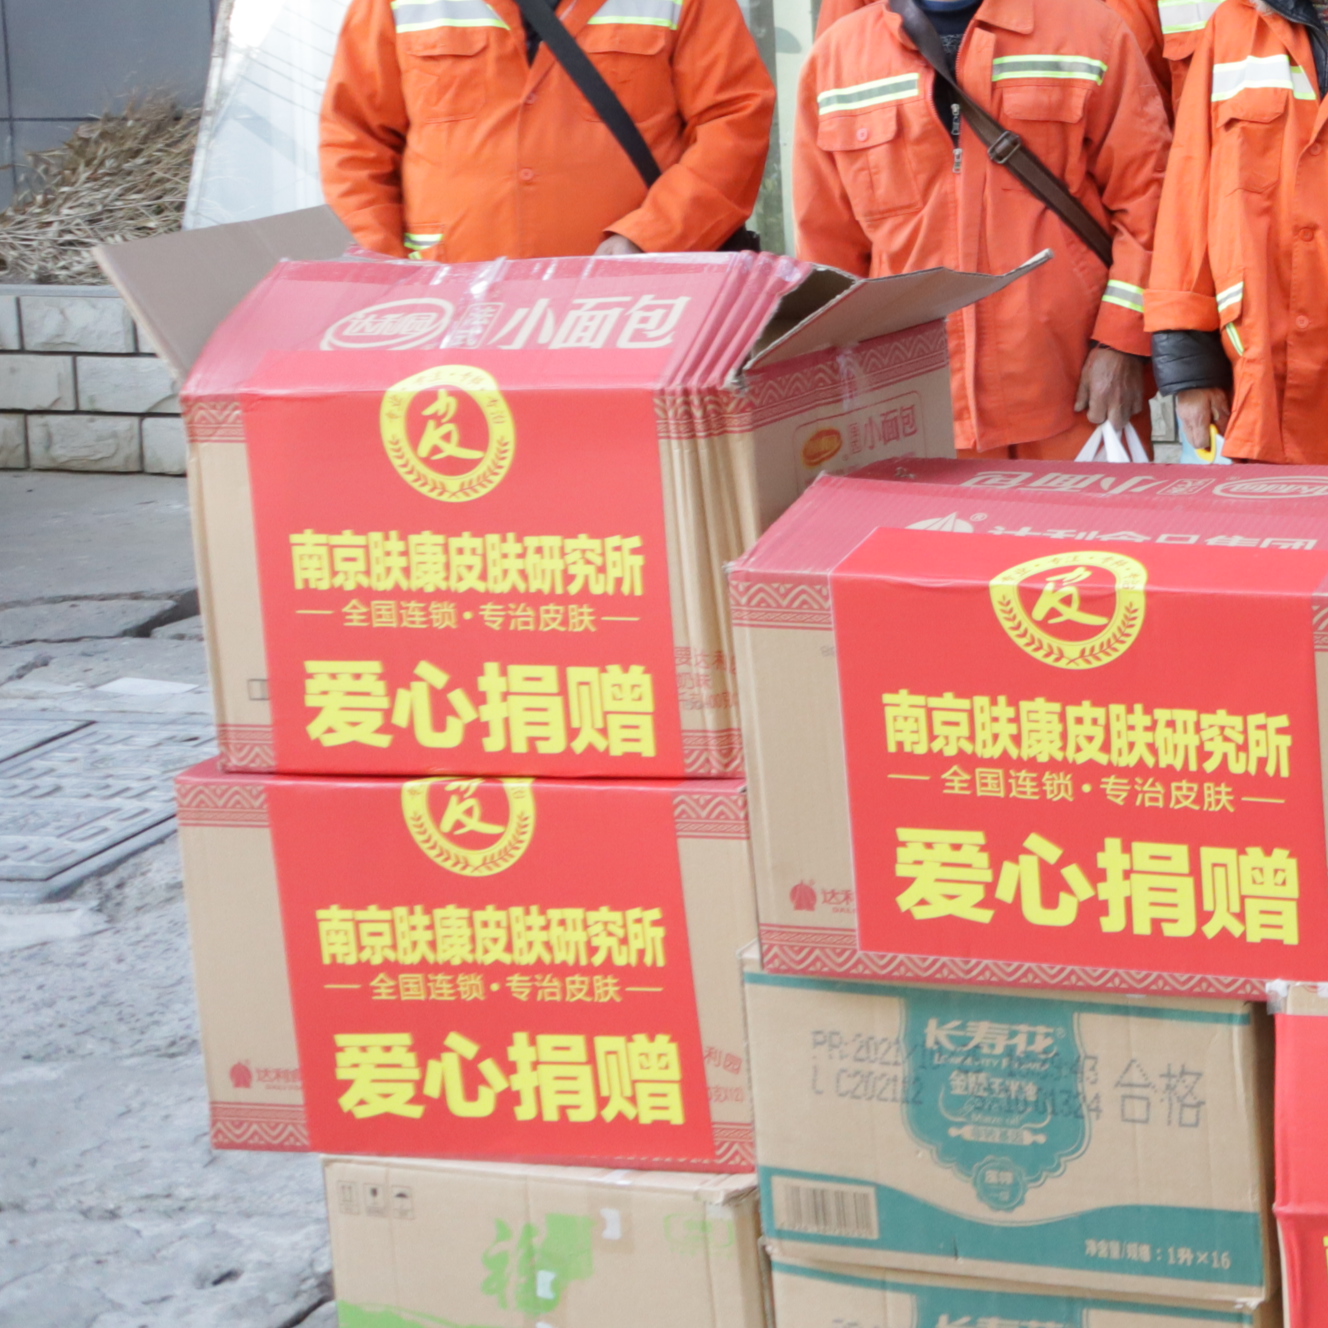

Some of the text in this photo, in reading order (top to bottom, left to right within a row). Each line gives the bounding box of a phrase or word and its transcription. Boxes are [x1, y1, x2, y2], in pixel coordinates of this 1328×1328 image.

[490, 294, 692, 350] 小面包
[288, 528, 646, 598] 南京肤康皮肤研究所
[341, 600, 599, 634] 全国连锁·专治皮肤
[303, 660, 658, 759] 爱心捐赠
[881, 688, 1292, 779] 南京肤康皮肤研究所
[940, 764, 1236, 812] 全国连锁·专治皮肤
[894, 827, 1301, 946] 爱心捐赠
[315, 905, 667, 967] 南京肤康皮肤研究所
[370, 972, 623, 1003] 全国连锁·专治皮肤
[925, 1016, 1058, 1058] 长寿花
[333, 1031, 686, 1126] 爱心捐赠
[1114, 1058, 1206, 1129] 合格
